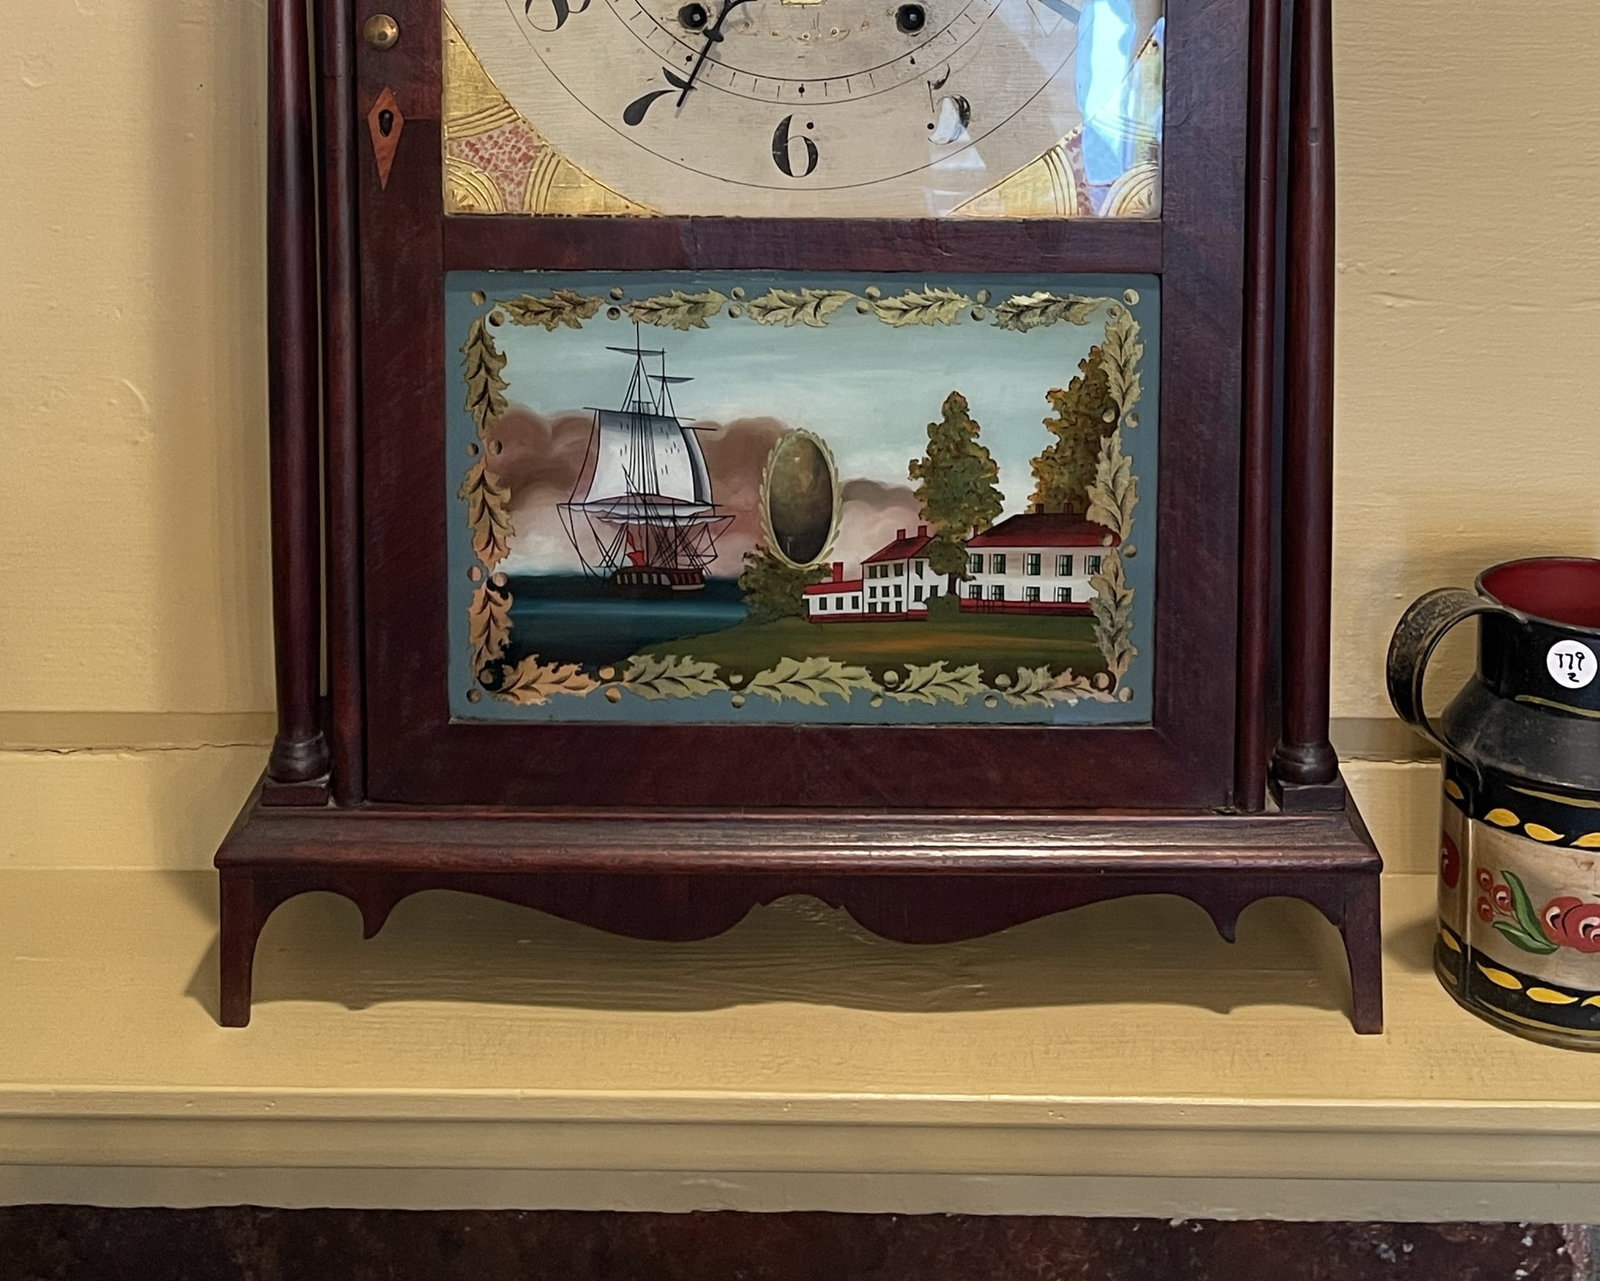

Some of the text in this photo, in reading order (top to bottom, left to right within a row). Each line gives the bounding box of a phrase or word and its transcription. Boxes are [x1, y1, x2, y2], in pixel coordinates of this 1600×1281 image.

[622, 66, 698, 127] 7
[927, 62, 971, 146] 5
[771, 113, 819, 178] 6
[1554, 651, 1585, 672] 779
